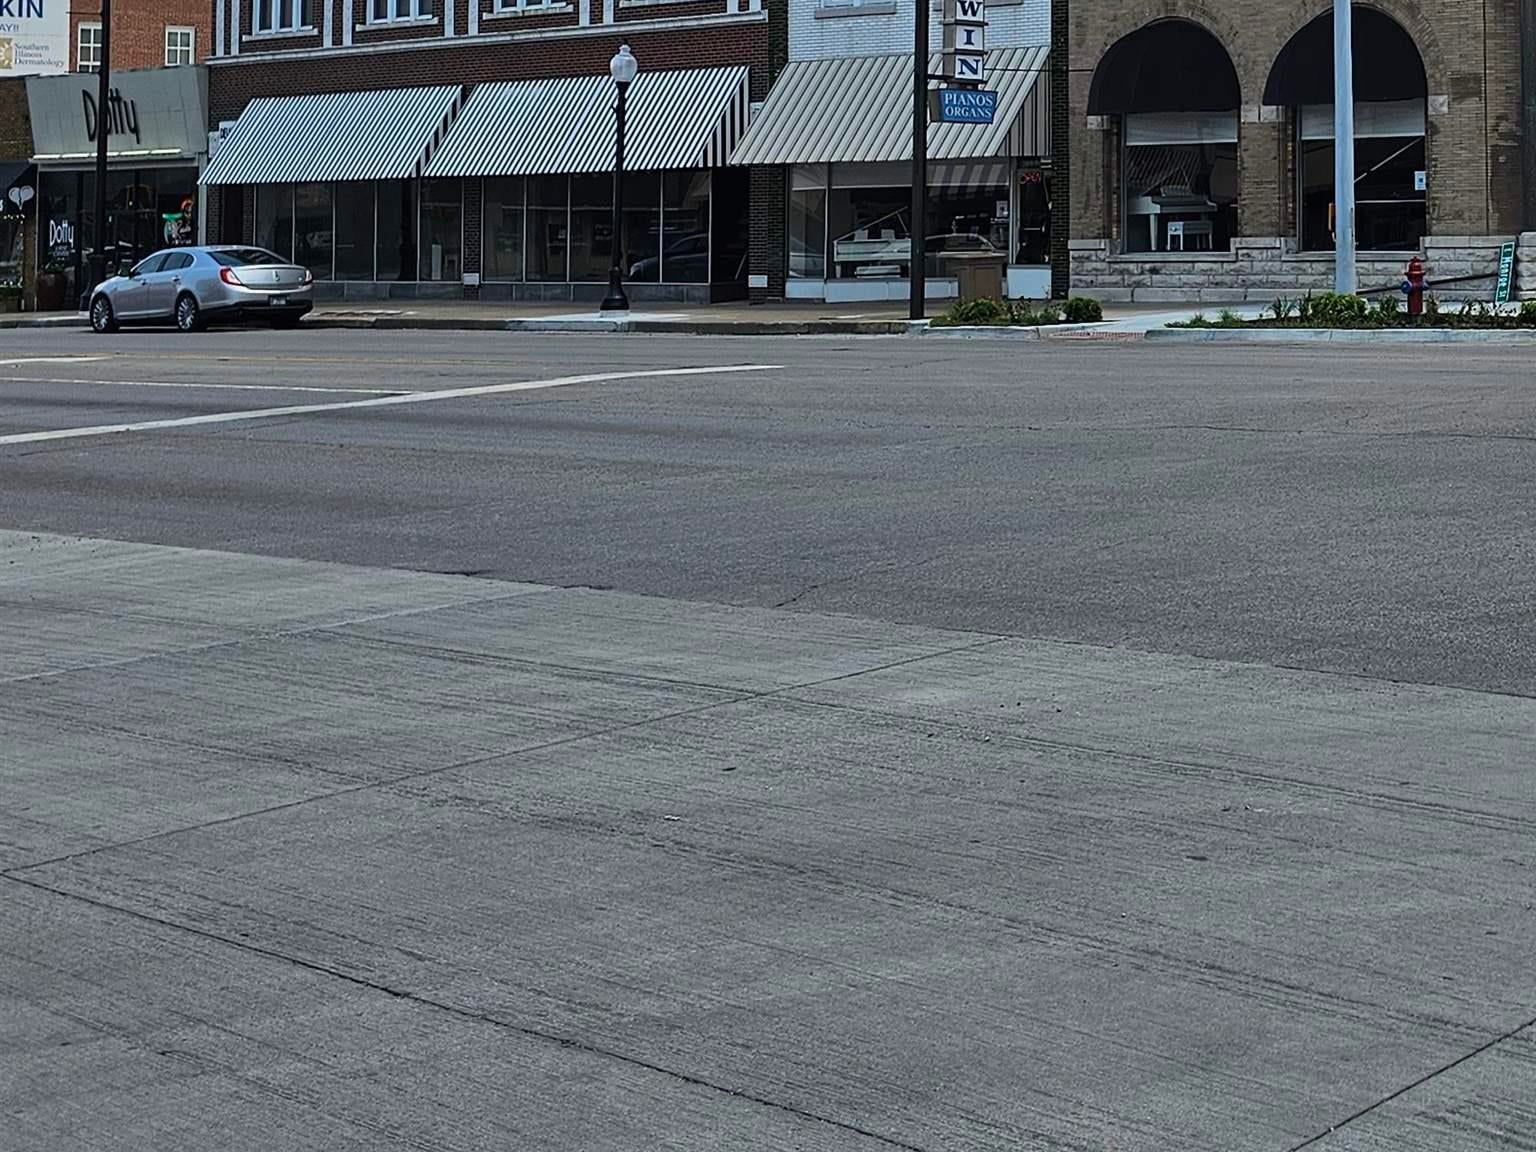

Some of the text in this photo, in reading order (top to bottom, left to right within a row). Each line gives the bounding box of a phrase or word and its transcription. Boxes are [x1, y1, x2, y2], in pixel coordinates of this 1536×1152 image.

[944, 93, 993, 106] PIANOS
[944, 106, 992, 118] ORGANS
[49, 219, 74, 248] Dotty
